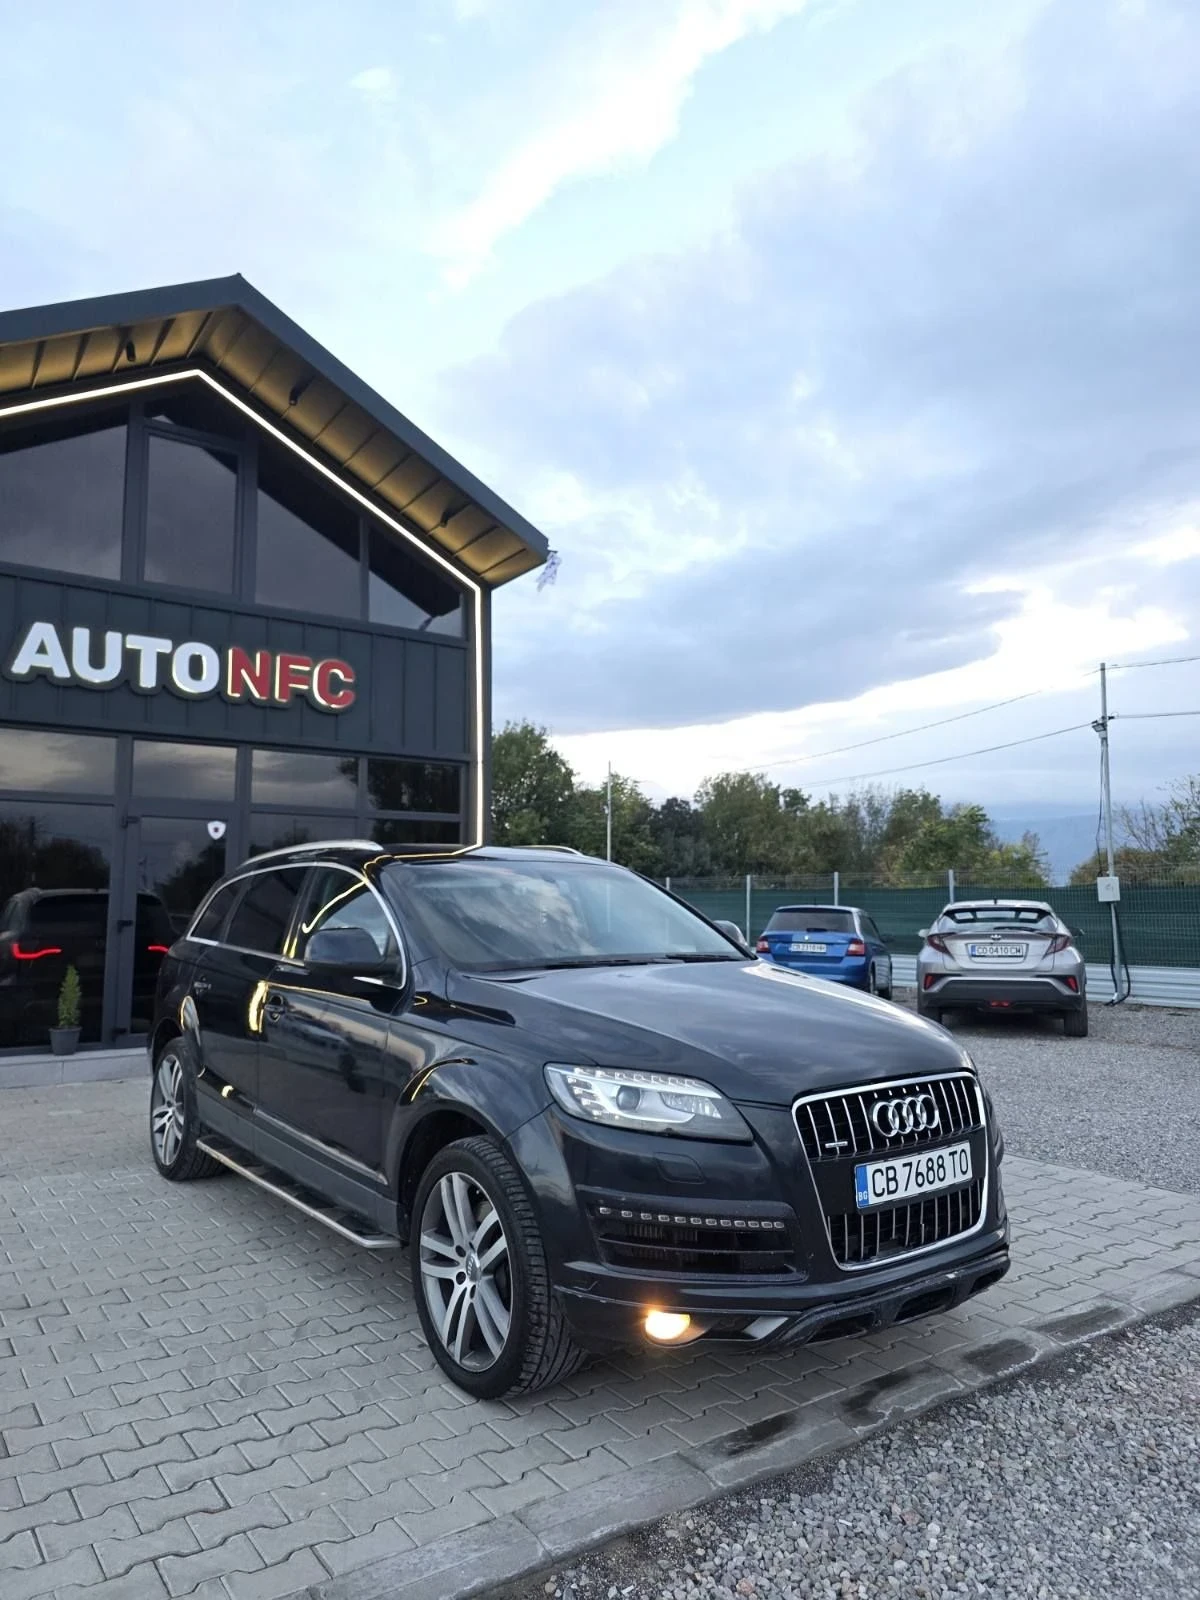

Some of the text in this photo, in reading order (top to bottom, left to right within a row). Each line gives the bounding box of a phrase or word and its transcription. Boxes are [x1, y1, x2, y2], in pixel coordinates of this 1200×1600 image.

[871, 1148, 969, 1198] CB 7688 TO
[858, 1191, 868, 1202] BG
